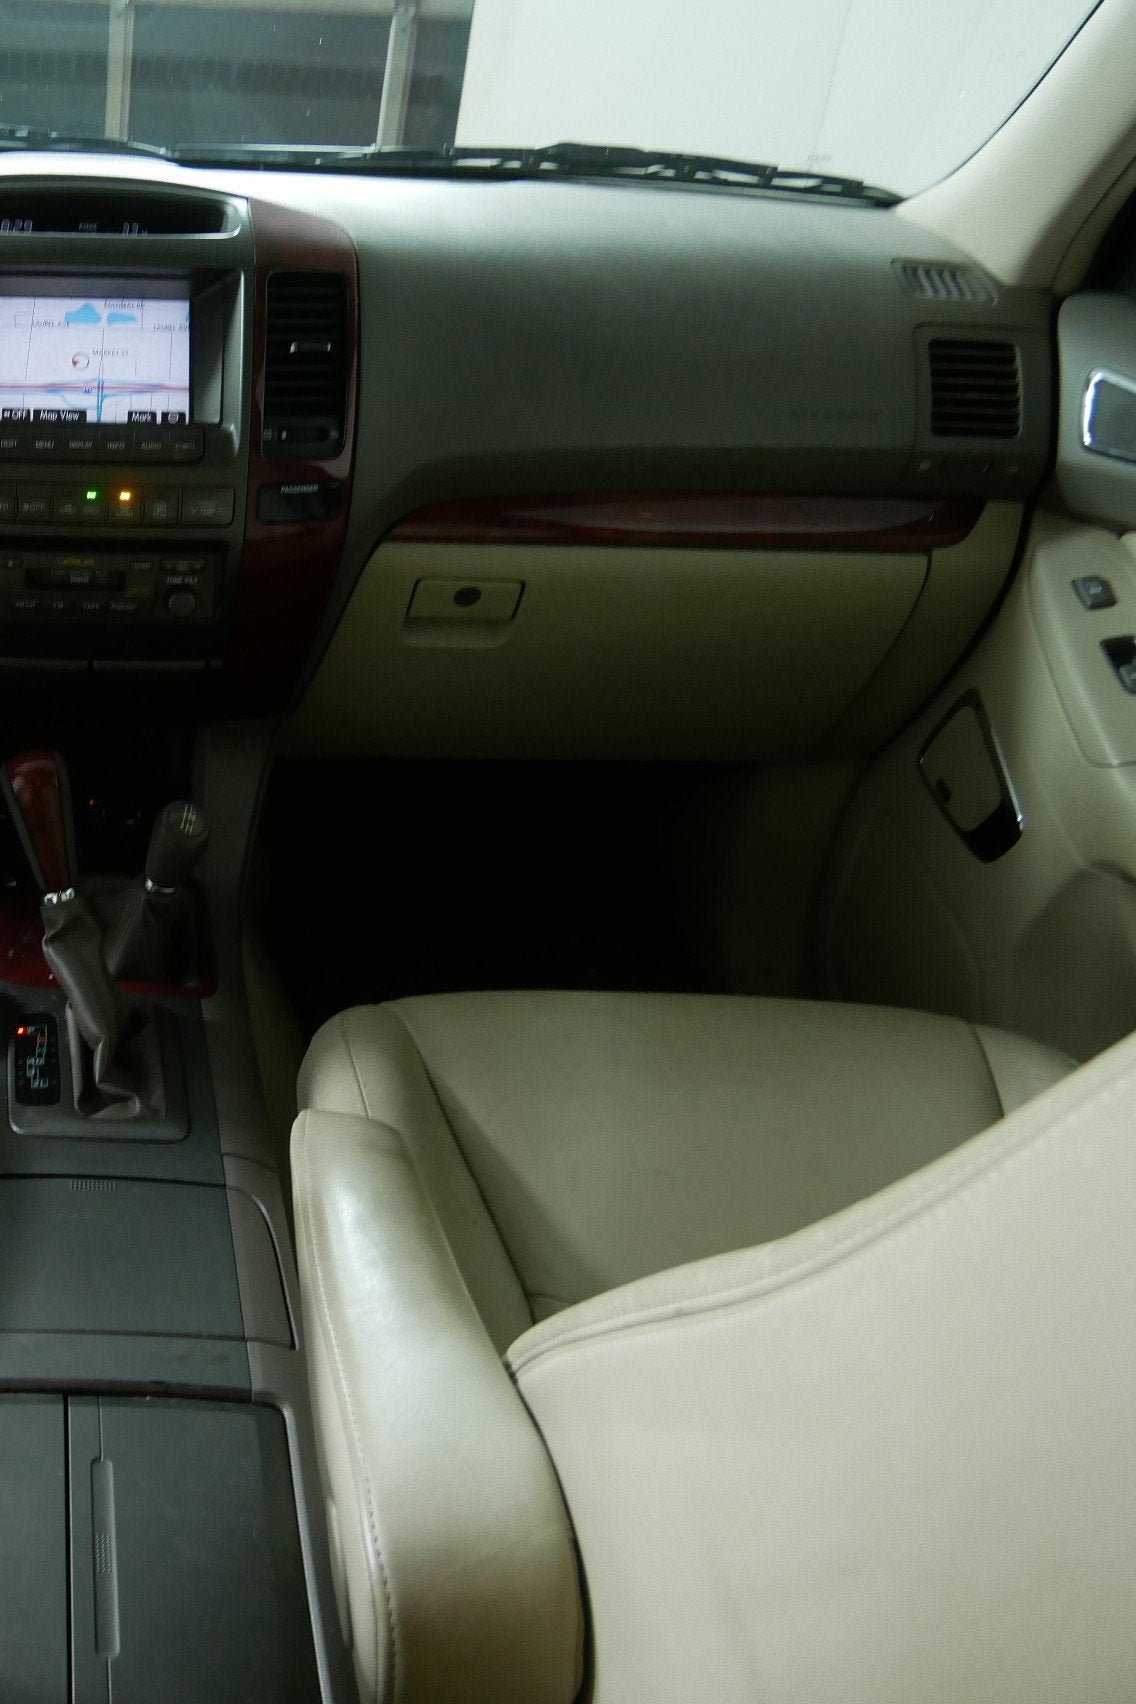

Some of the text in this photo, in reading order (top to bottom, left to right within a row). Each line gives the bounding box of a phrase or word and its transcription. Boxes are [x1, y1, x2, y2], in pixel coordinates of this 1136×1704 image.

[39, 410, 80, 422] Map View
[131, 411, 152, 423] Mark
